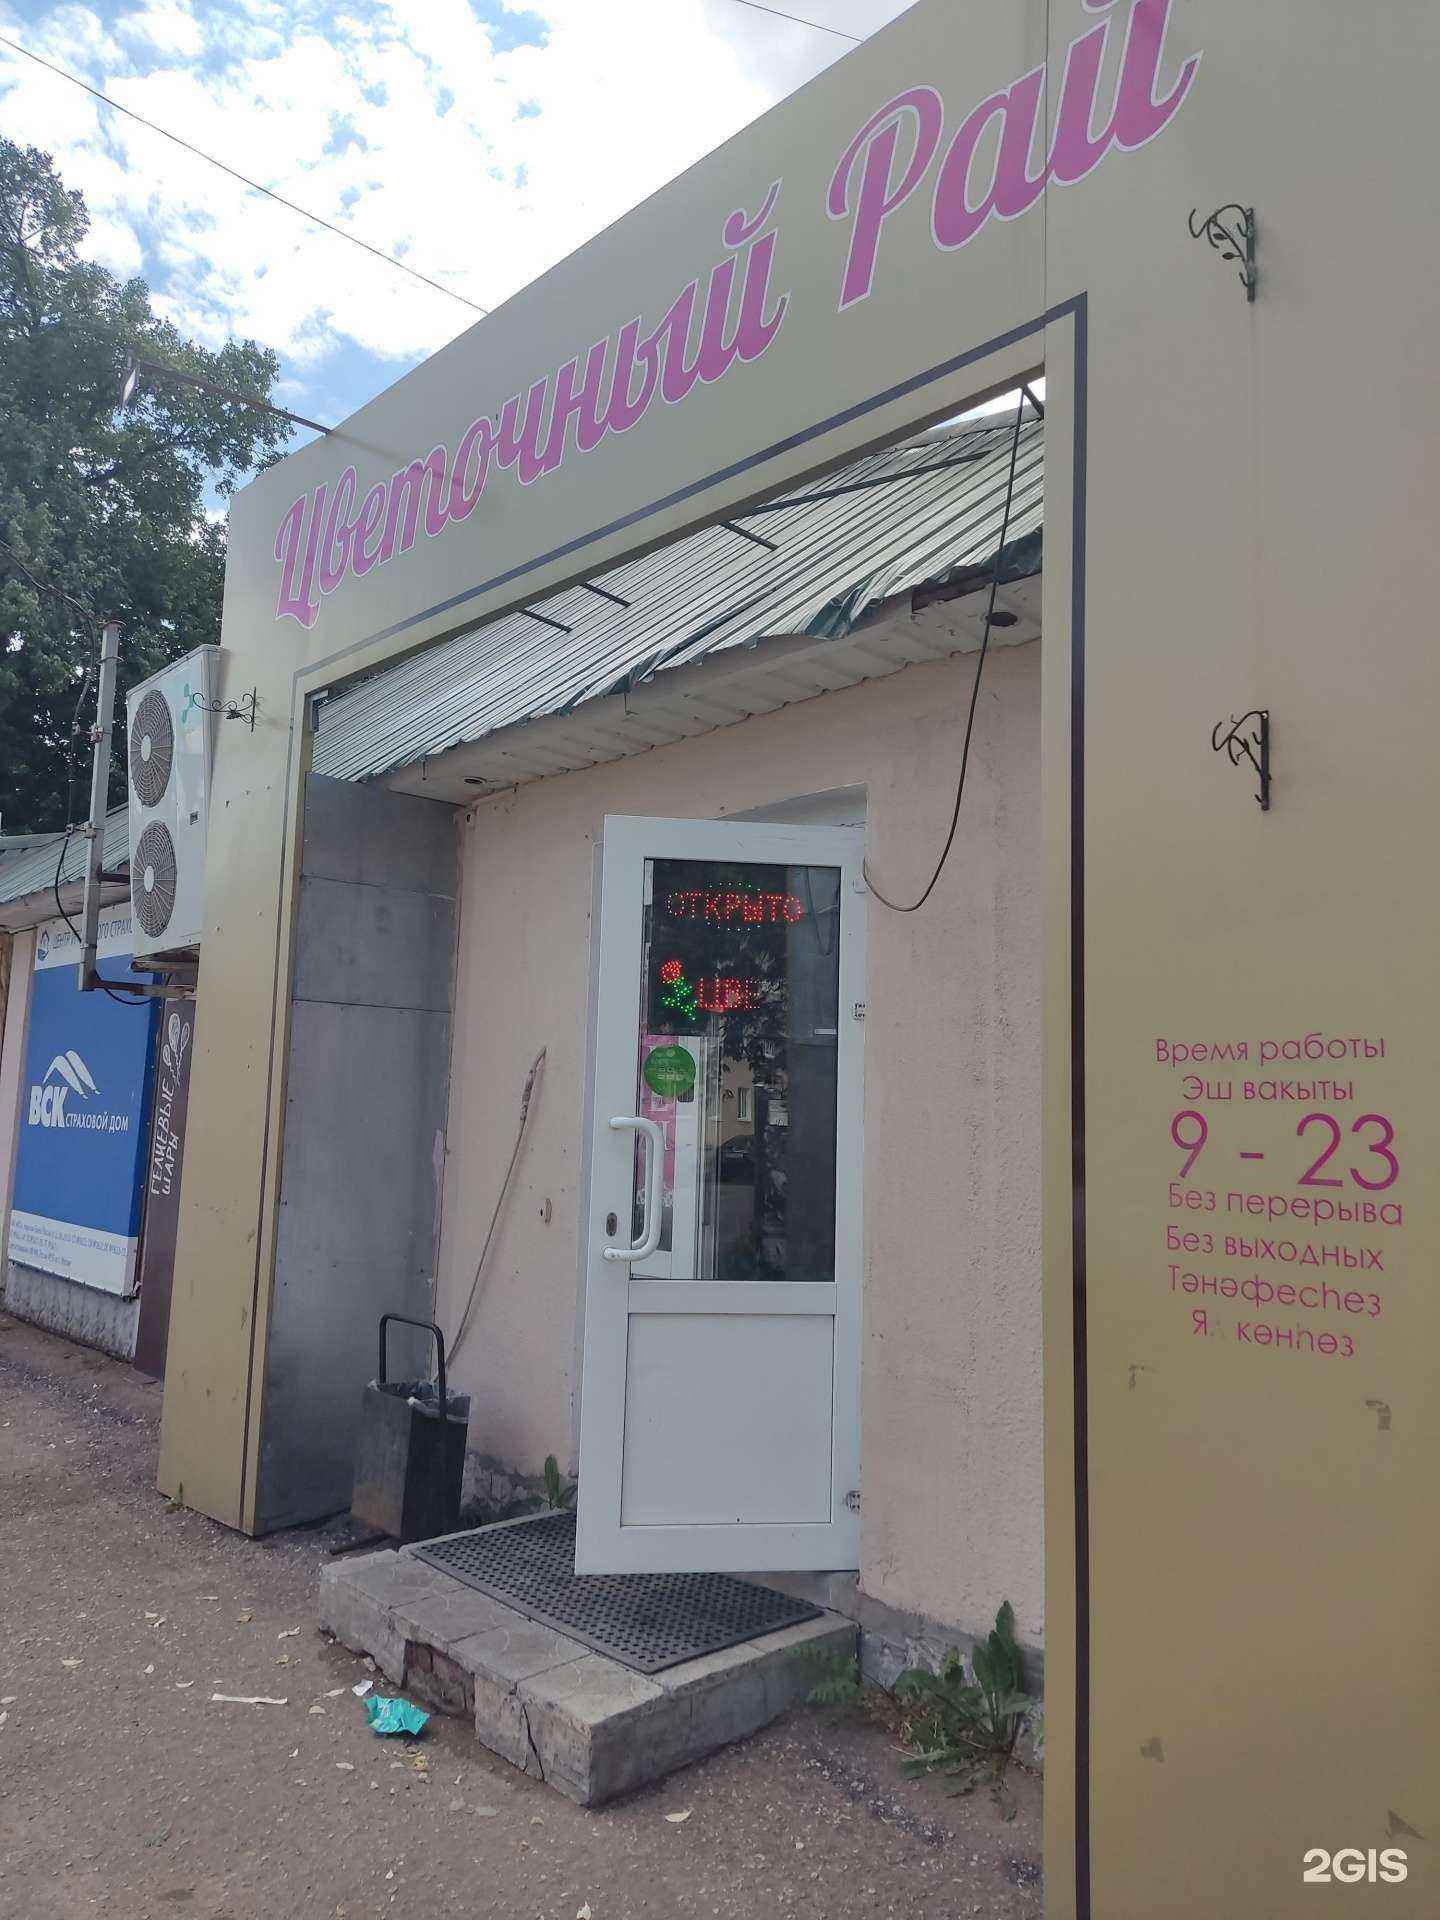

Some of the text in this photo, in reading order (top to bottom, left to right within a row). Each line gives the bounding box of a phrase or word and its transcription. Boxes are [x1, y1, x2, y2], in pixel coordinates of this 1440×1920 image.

[272, 0, 1204, 630] Цветочный Рай
[666, 891, 802, 922] ОТКРЫТО
[1155, 1032, 1385, 1067] Время работы
[28, 1085, 69, 1128] ВСК
[1182, 1075, 1353, 1101] Эш вакыты
[65, 1111, 129, 1135] СТРАХОВОЙ ДОМ
[150, 1078, 175, 1194] ГЕЛИЕВЫЕ
[162, 1132, 179, 1195] ШАРЫ
[1171, 1110, 1208, 1178] 9
[1296, 1112, 1399, 1190] 23
[1168, 1183, 1403, 1226] Без перерыва
[1167, 1225, 1385, 1272] Без выходных
